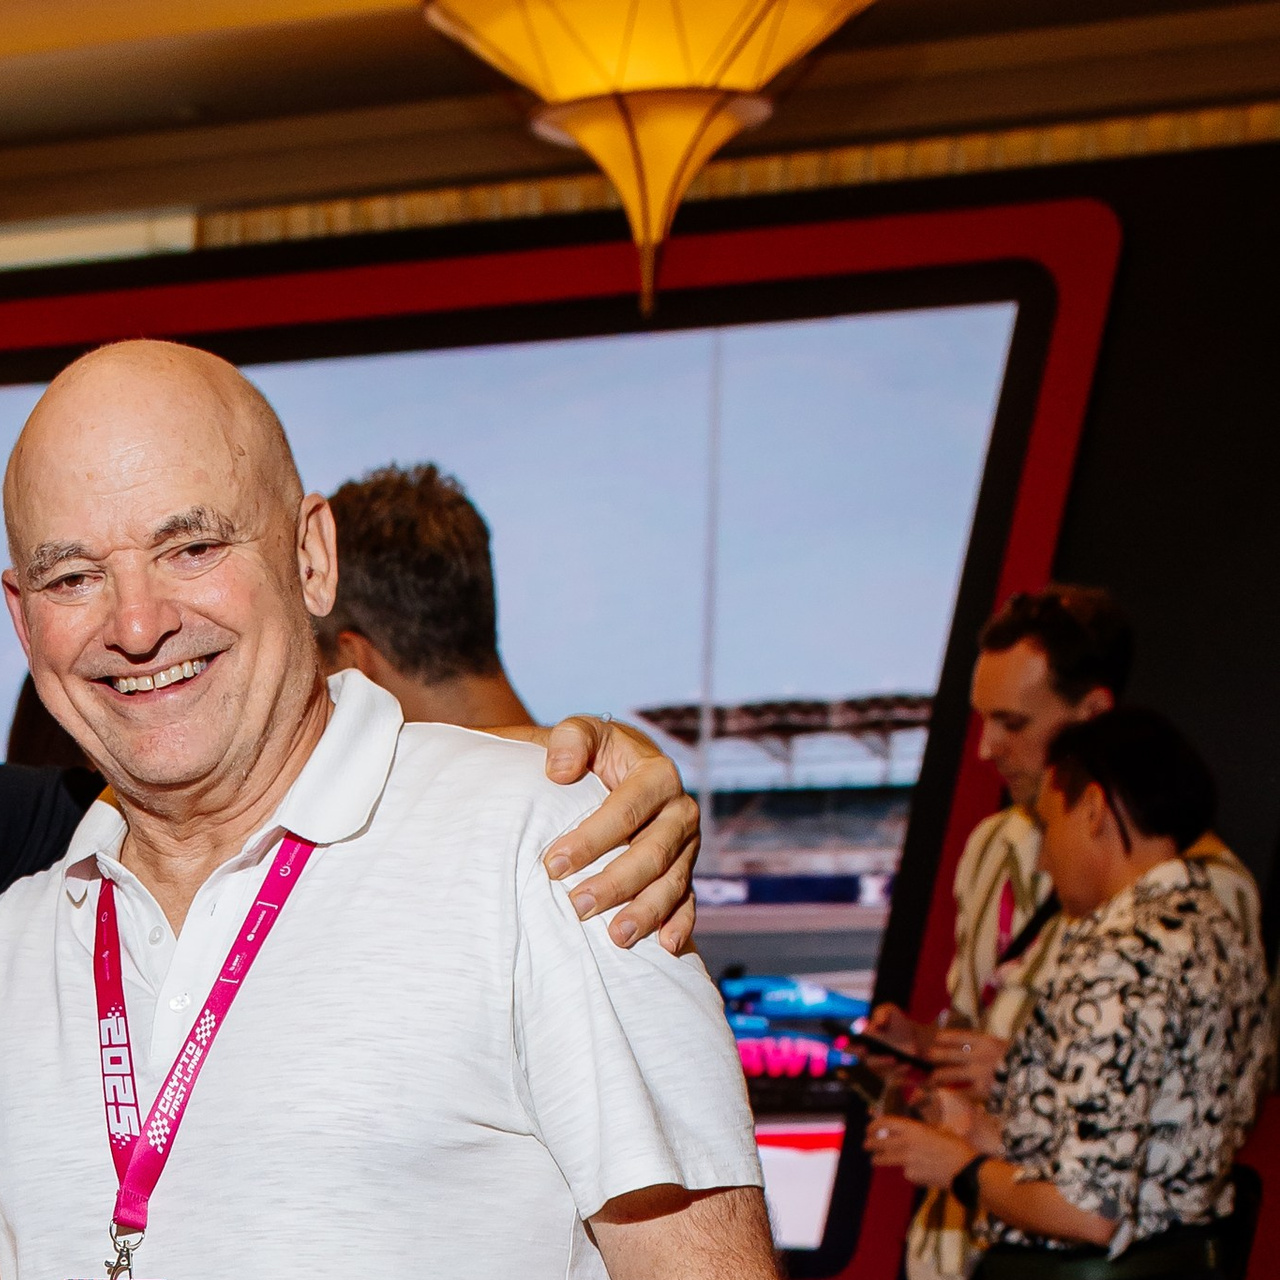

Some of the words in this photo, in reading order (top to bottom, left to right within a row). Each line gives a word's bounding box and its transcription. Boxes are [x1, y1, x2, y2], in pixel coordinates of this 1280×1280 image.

[100, 1016, 141, 1137] 2025
[158, 1041, 197, 1114] CRYPTO
[169, 1083, 187, 1120] FAST
[183, 1046, 204, 1083] LANE
